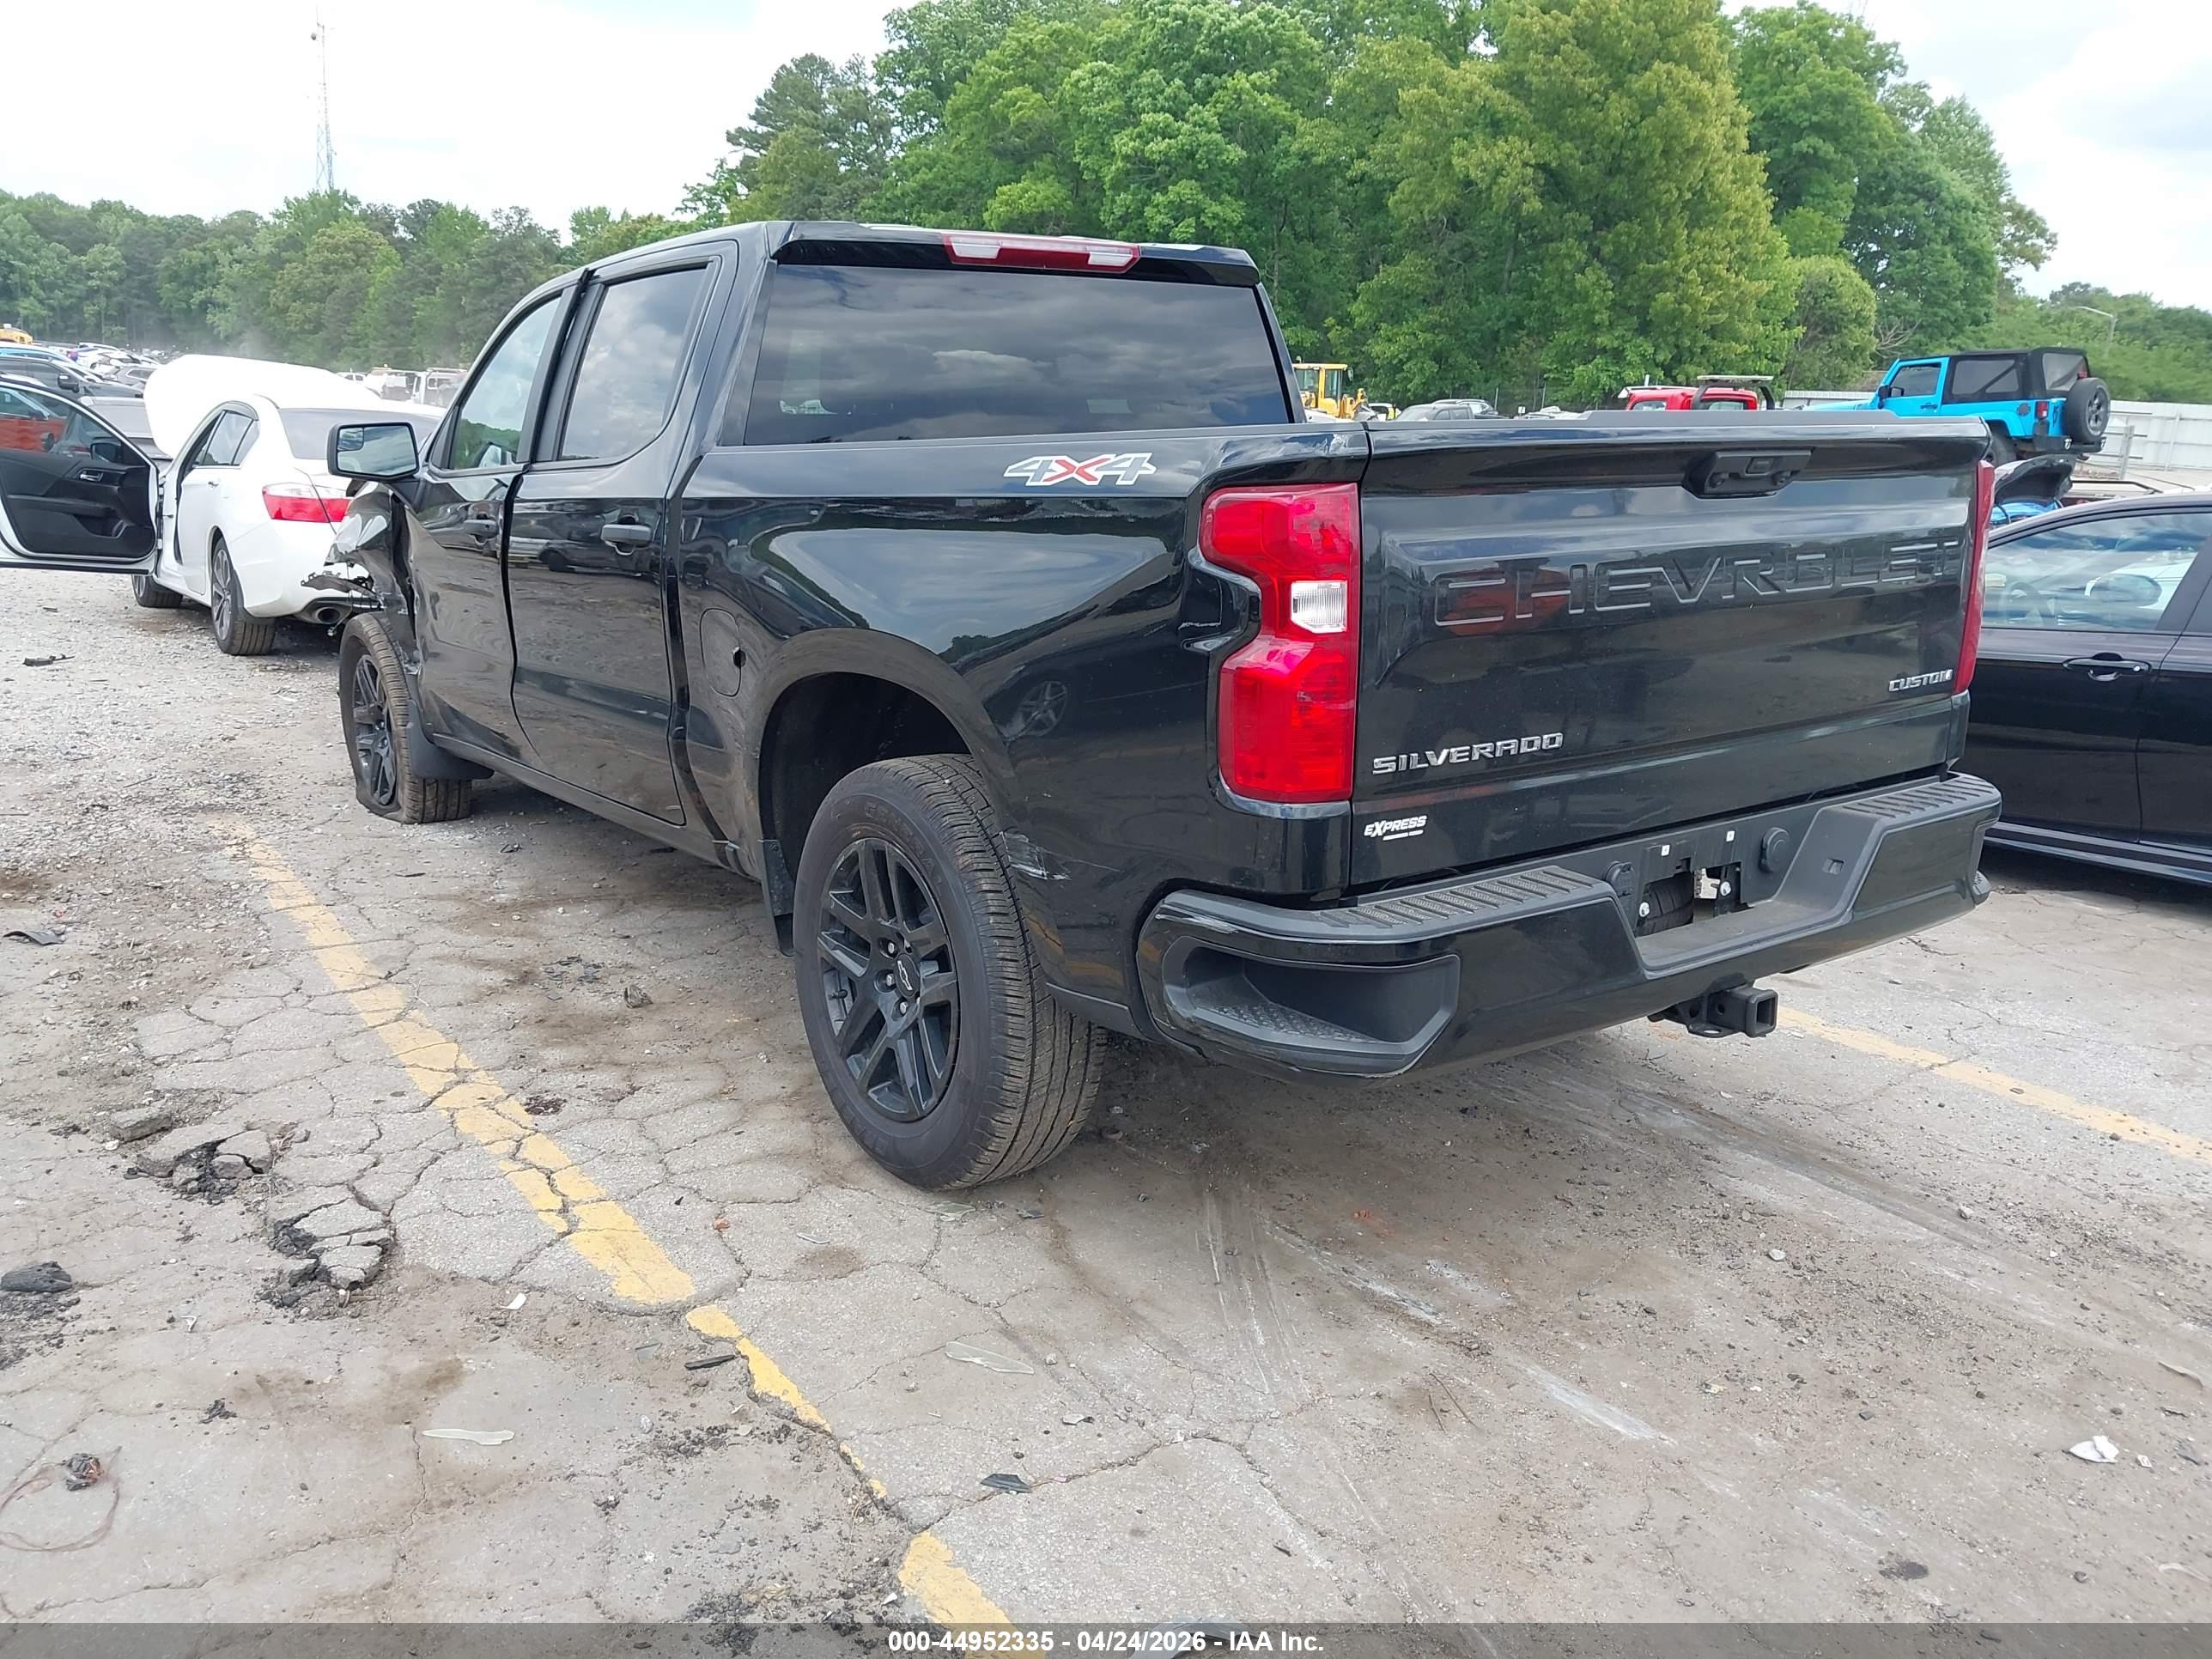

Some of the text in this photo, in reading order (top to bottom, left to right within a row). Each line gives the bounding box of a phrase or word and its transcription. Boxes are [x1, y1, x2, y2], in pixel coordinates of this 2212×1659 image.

[1435, 540, 1960, 627] CHEVROLET
[1888, 669, 1954, 692] CUSTOM
[1372, 732, 1564, 775] SILVERADO
